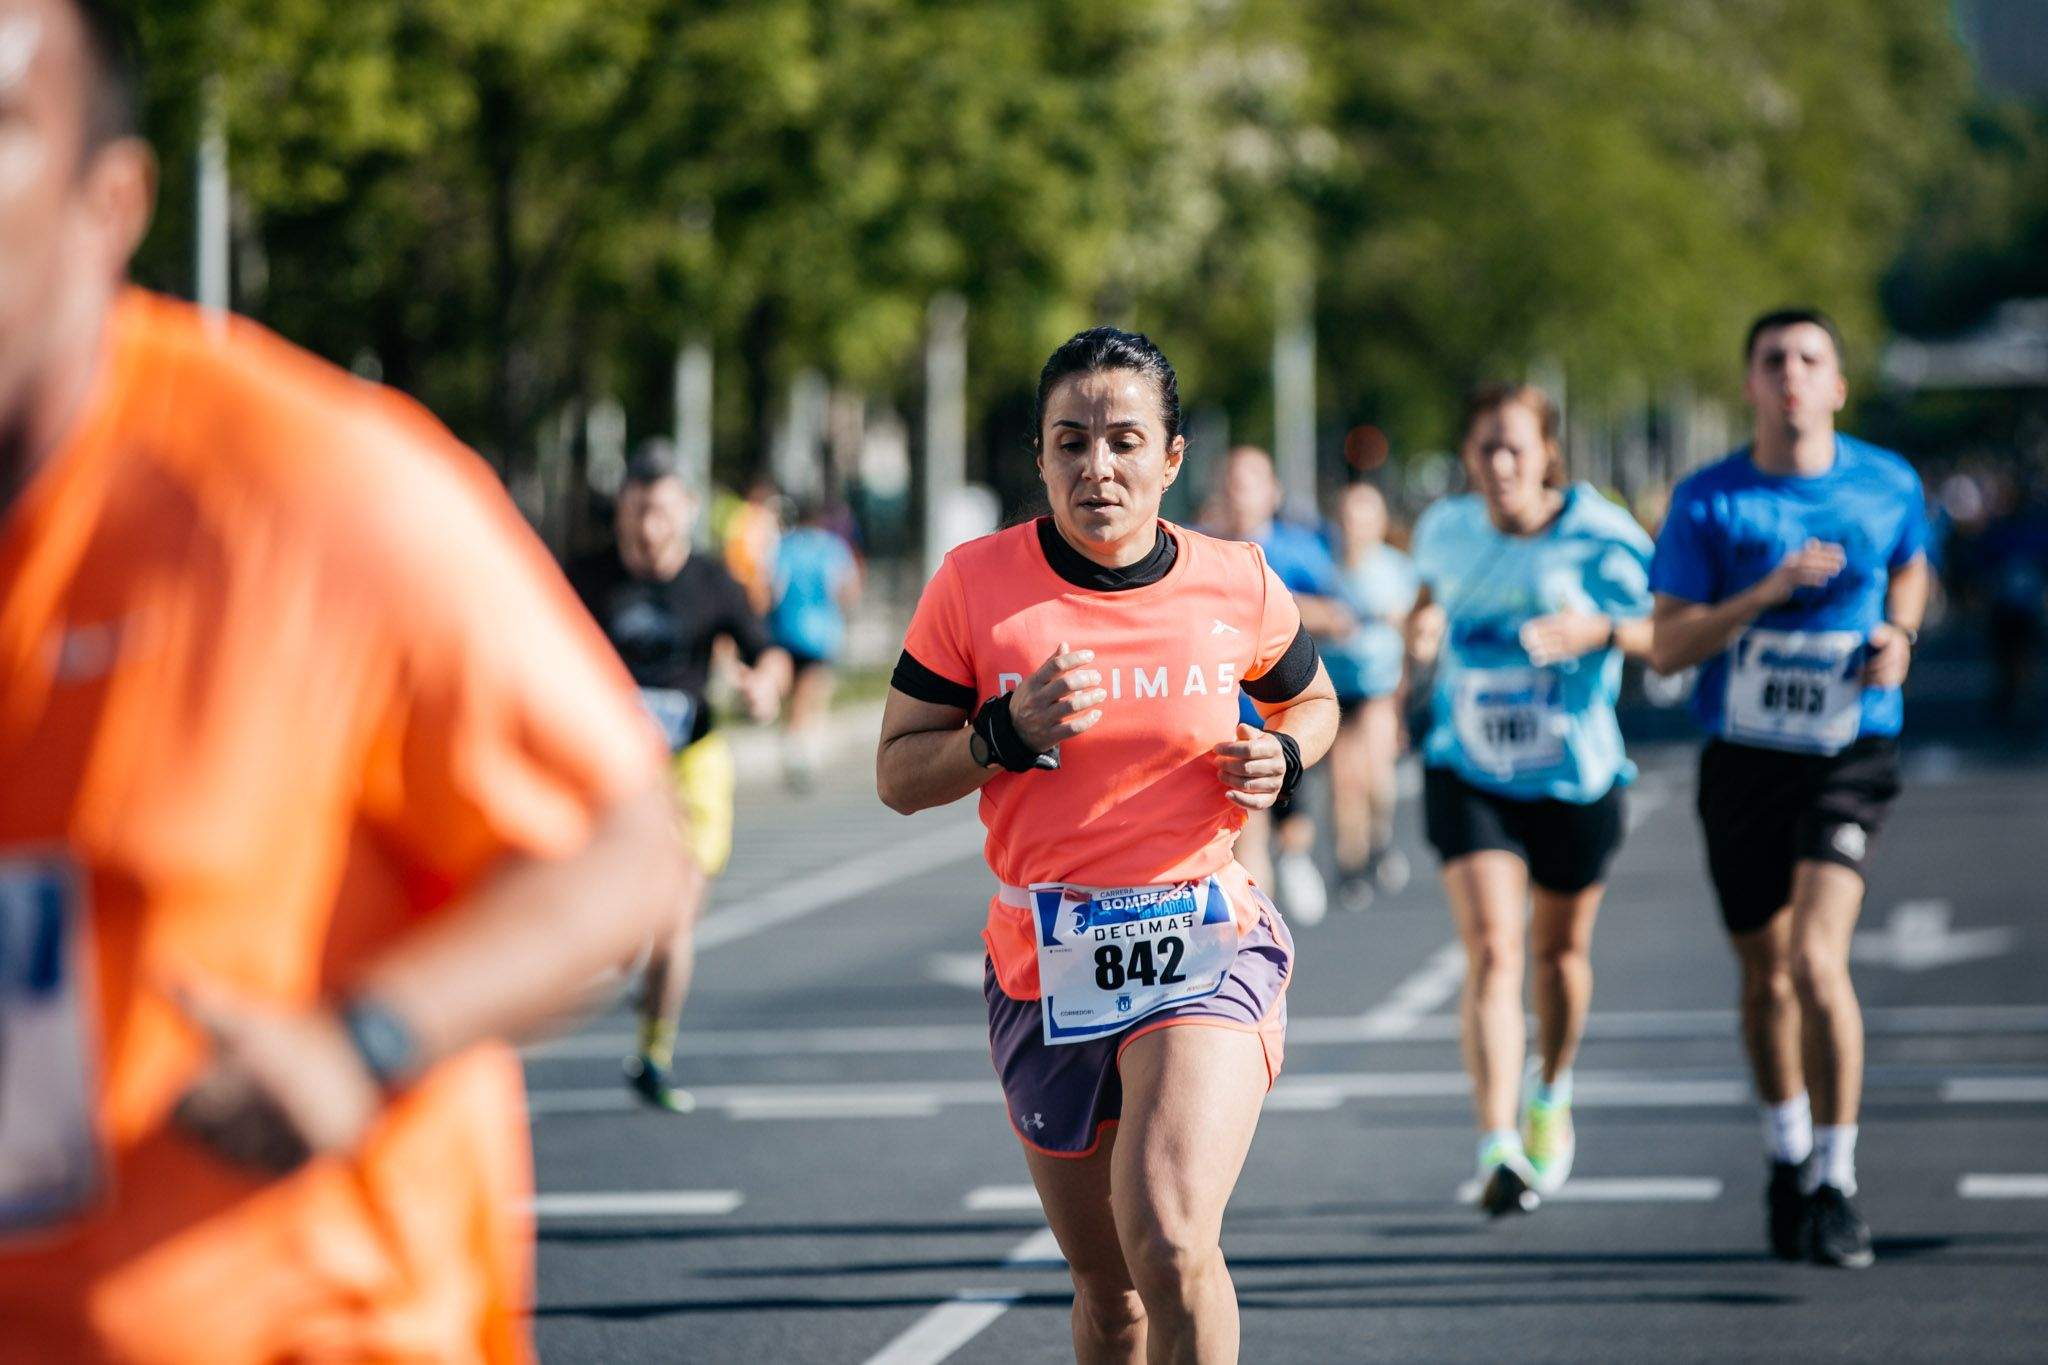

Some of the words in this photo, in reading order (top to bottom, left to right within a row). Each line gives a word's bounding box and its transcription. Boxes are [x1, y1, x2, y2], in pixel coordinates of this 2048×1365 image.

[998, 662, 1237, 700] DIMAS
[1100, 887, 1135, 898] CARRERA
[1152, 898, 1194, 918] MADRID
[1094, 914, 1194, 942] DECIMAS
[1094, 936, 1187, 991] 842
